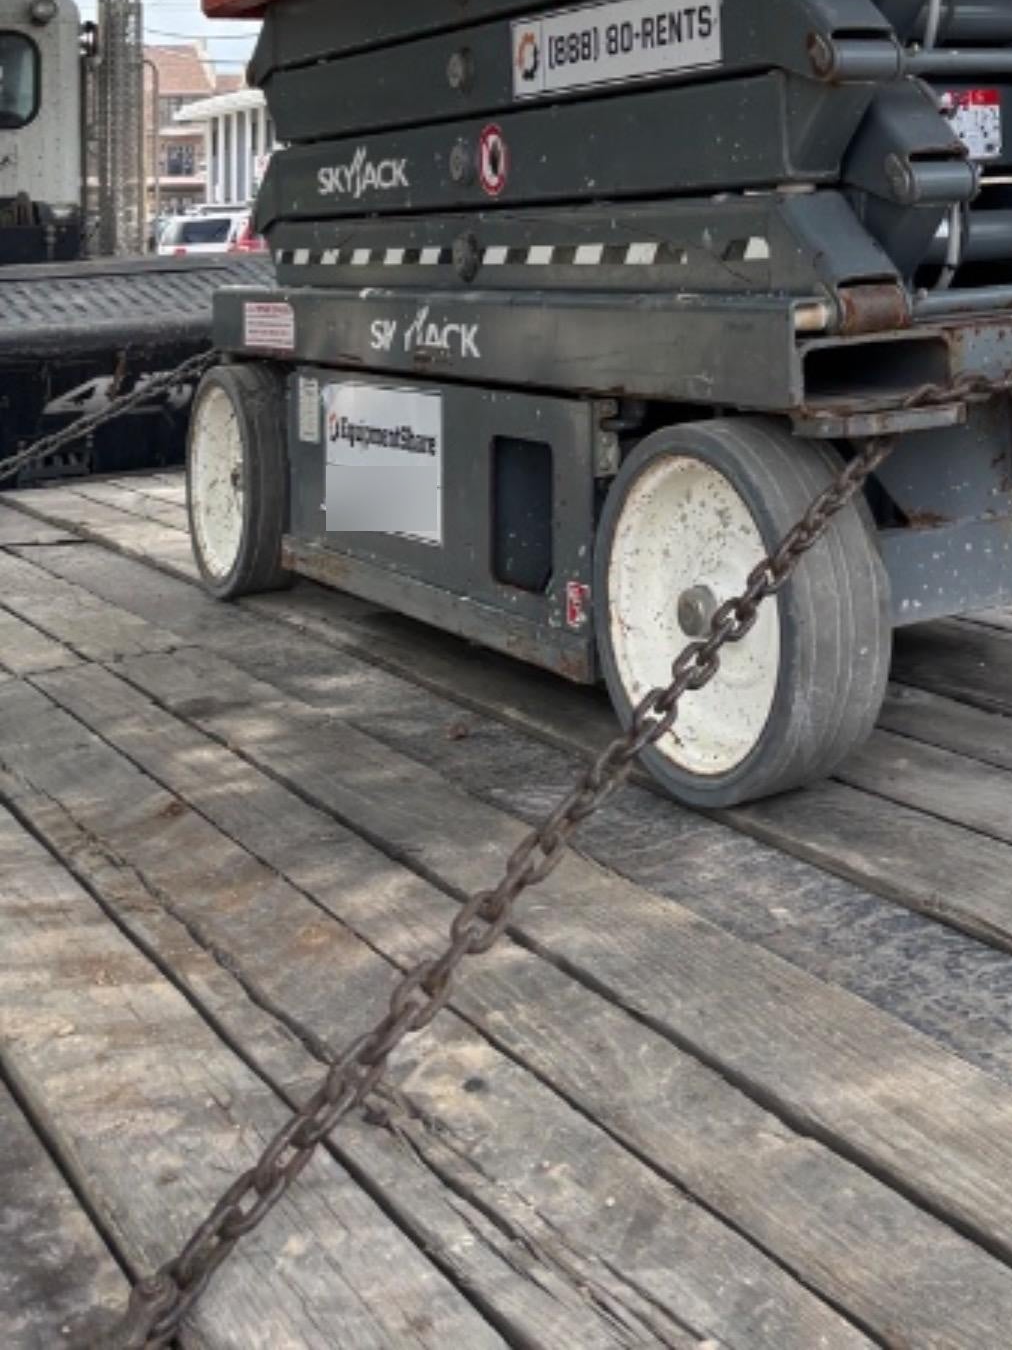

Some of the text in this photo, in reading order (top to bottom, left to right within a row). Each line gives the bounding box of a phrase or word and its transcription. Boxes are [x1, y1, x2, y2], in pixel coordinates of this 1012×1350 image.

[548, 5, 712, 70] (888) 80-RENTS
[317, 146, 408, 198] SKYJACK
